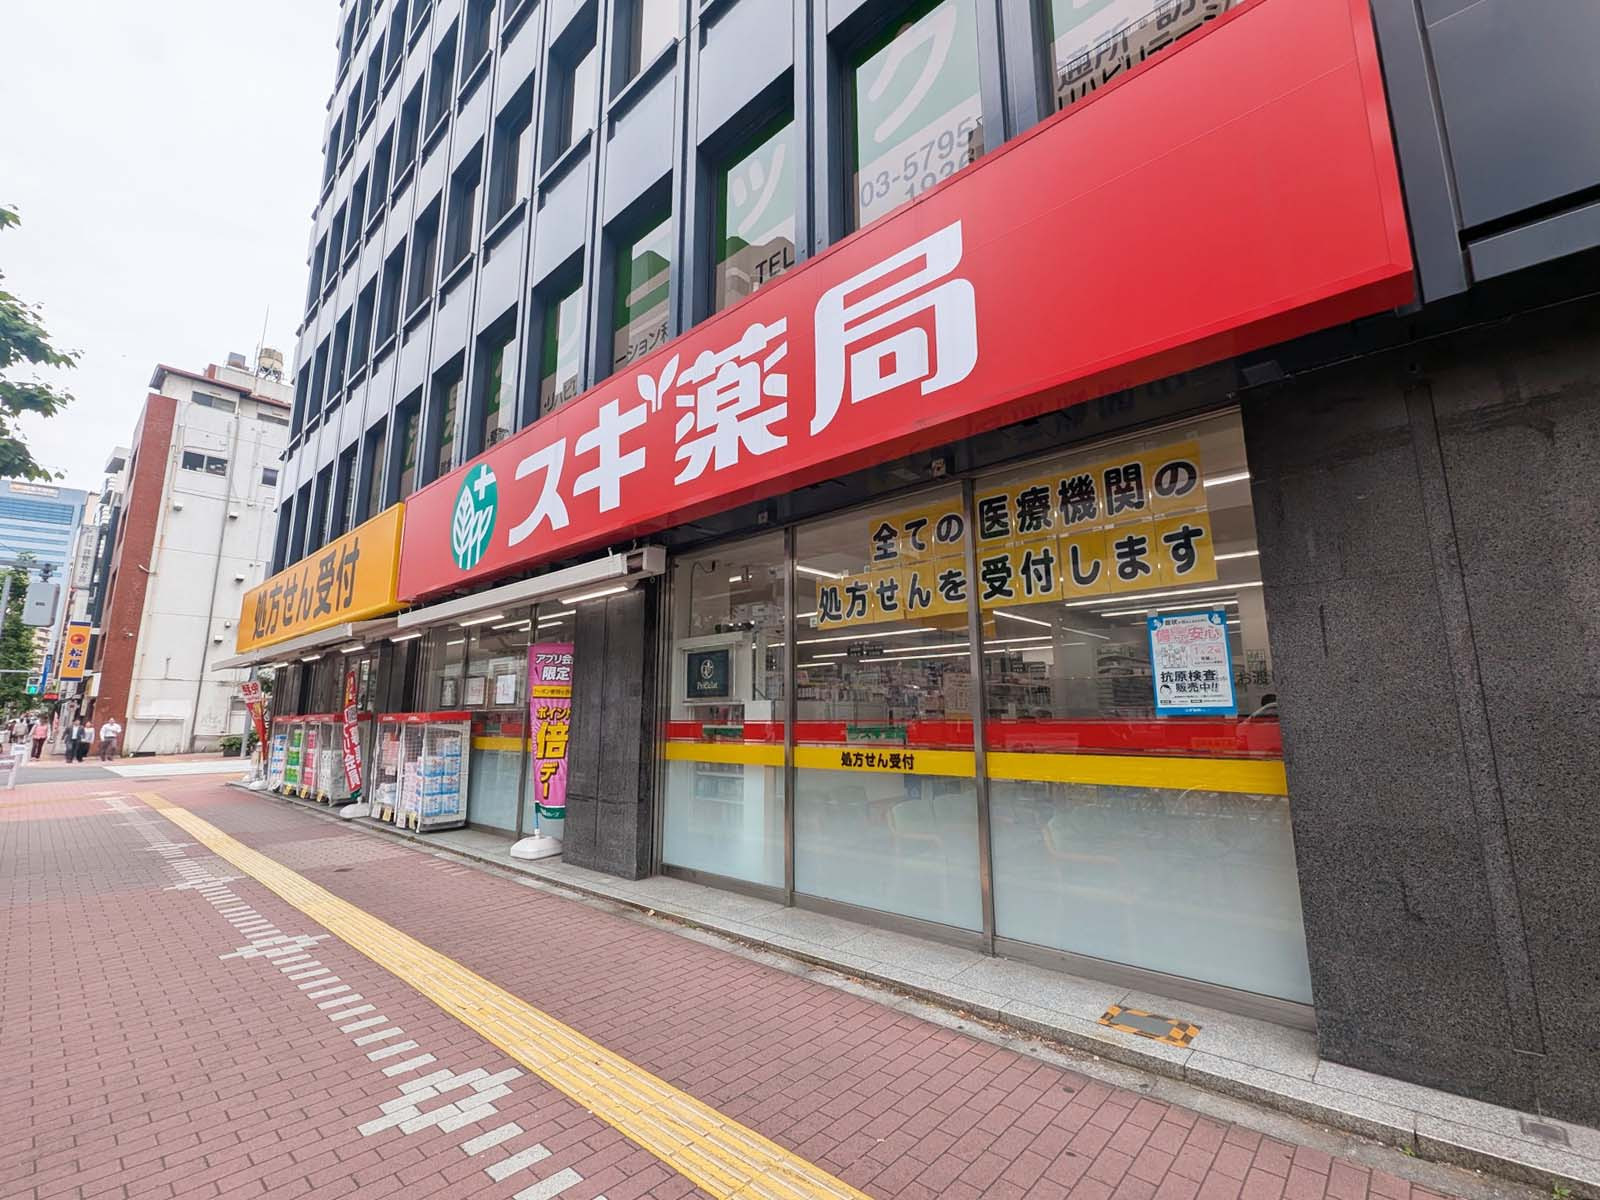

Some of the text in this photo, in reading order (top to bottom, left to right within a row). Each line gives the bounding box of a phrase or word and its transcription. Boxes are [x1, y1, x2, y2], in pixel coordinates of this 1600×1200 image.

[756, 248, 795, 284] TEL
[508, 219, 978, 547] スギ薬局
[252, 536, 360, 641] 処方せん受付
[541, 666, 571, 681] 限定
[1160, 669, 1216, 683] 抗原検査
[841, 751, 914, 770] 処方せん受付
